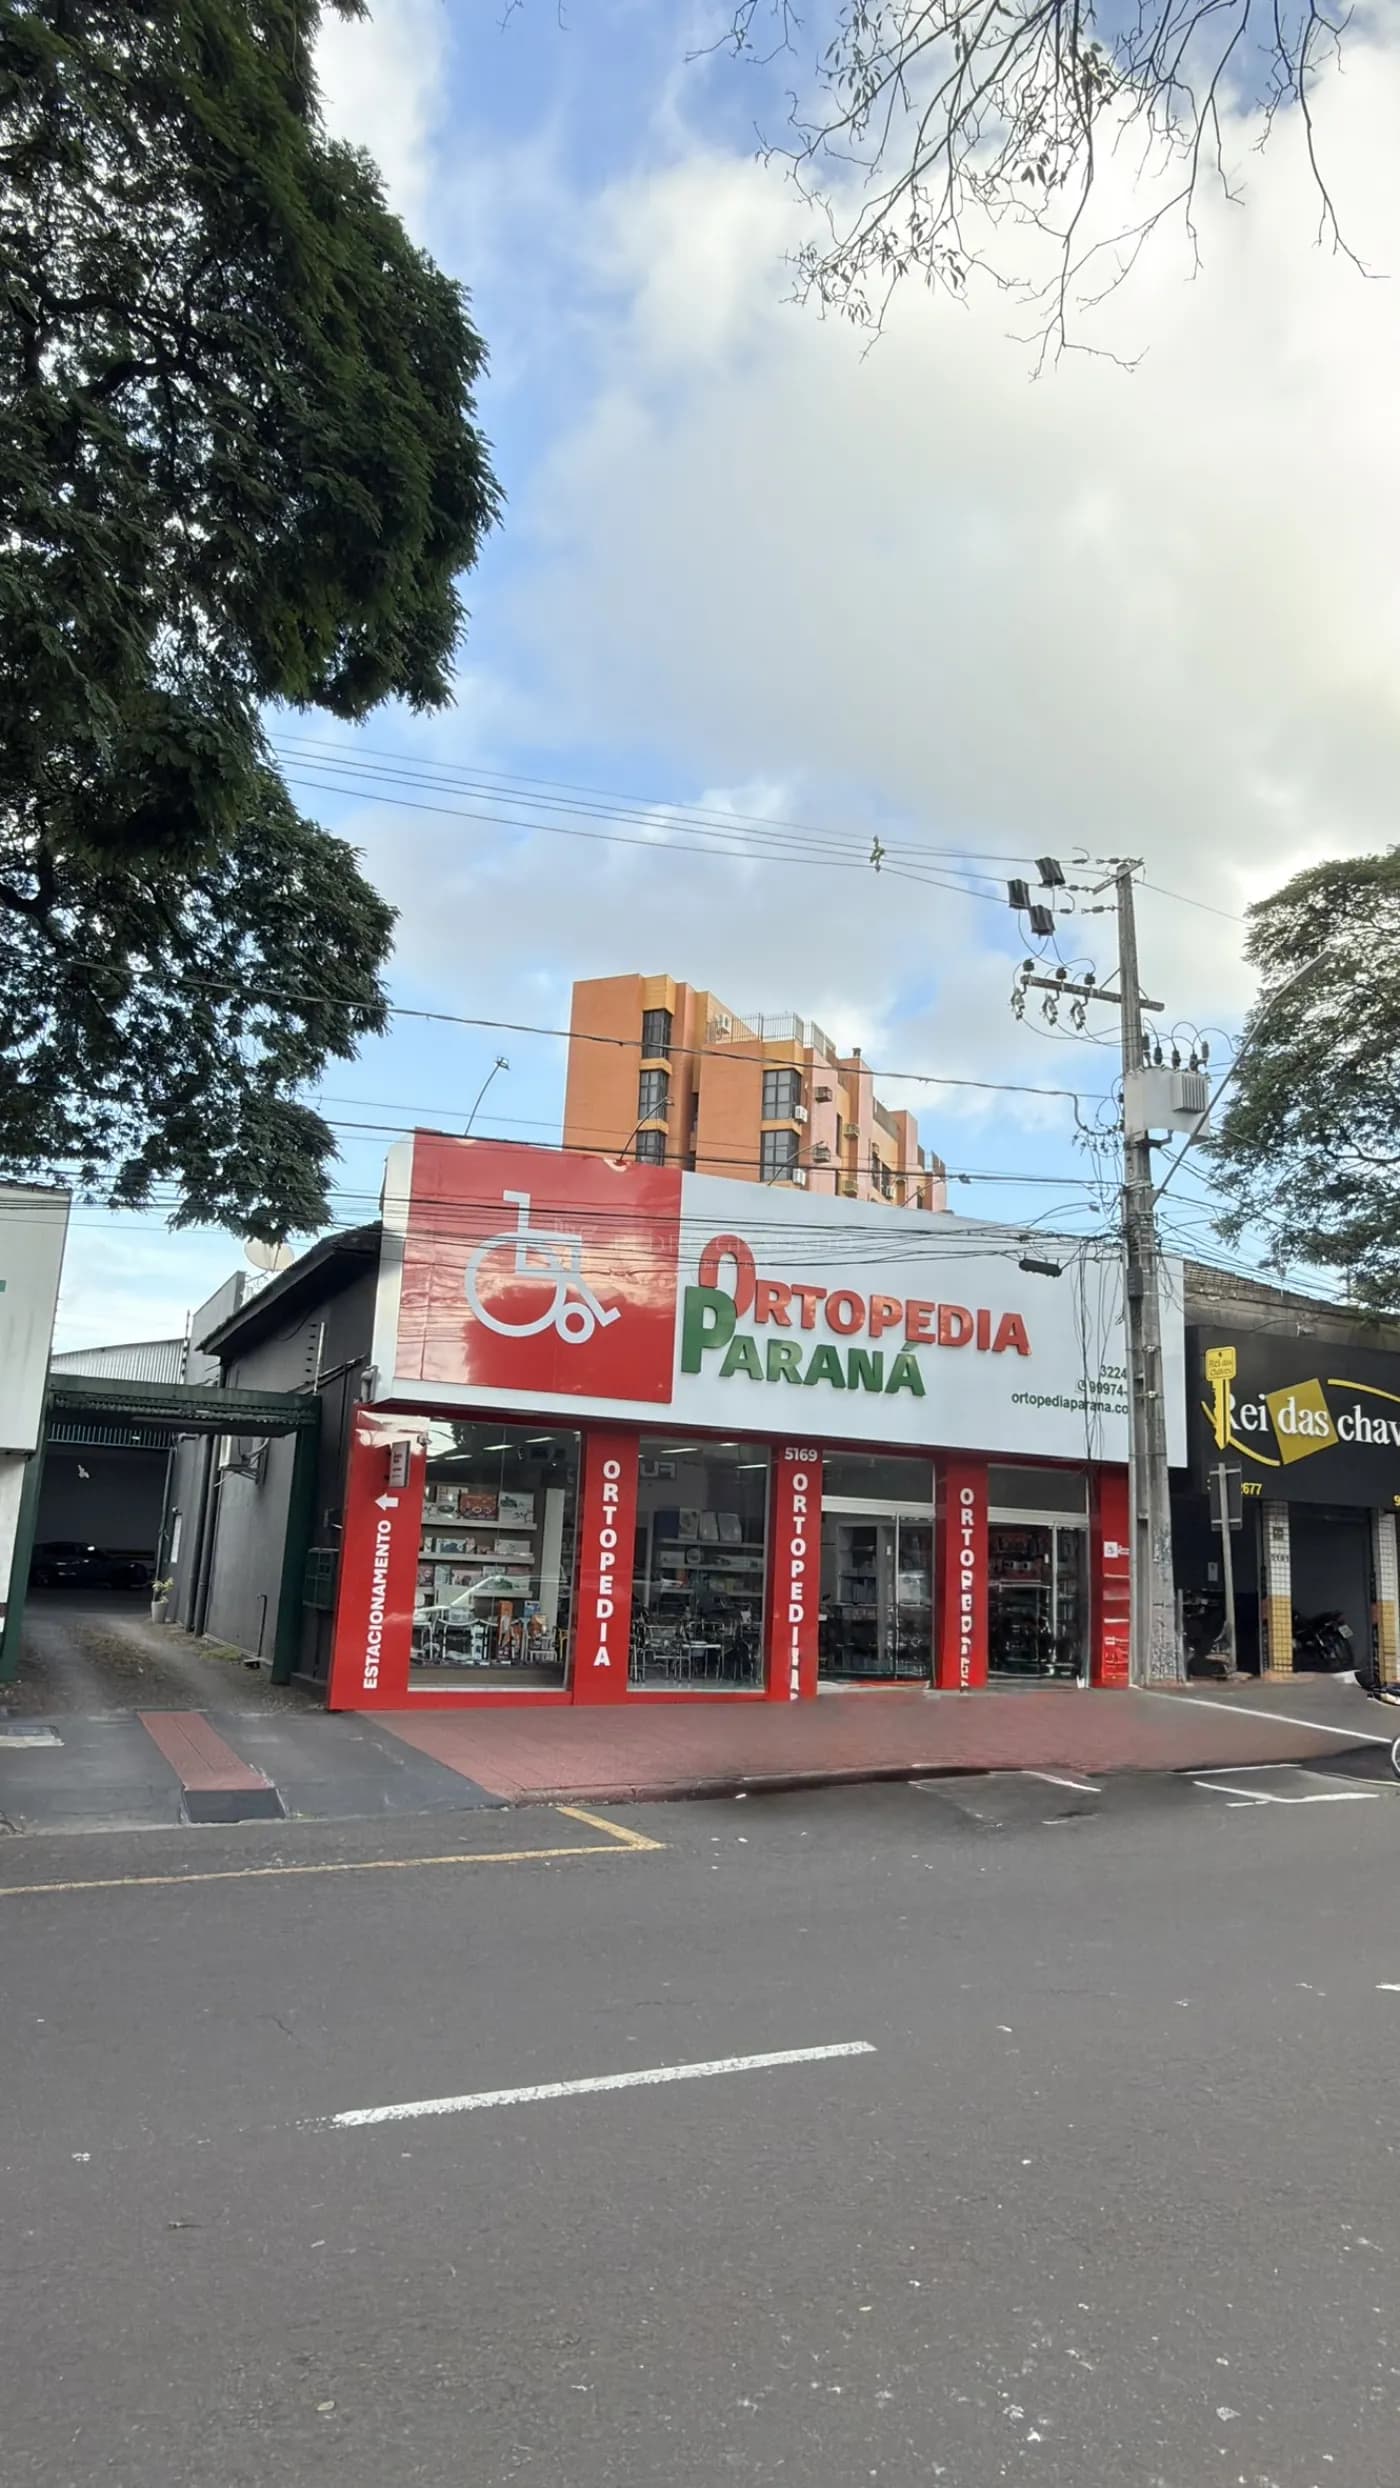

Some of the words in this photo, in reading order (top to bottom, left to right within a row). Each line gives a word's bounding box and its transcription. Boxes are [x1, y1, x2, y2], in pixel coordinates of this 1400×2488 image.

[681, 1286, 926, 1397] PARANÁ
[698, 1234, 1032, 1356] ORTOPEDIA
[784, 1447, 818, 1462] 5169
[1277, 1396, 1330, 1437] das
[1241, 1482, 1262, 1495] 677
[363, 1519, 392, 1690] ESTACIONAMENTO
[593, 1460, 621, 1666] ORTOPEDIA
